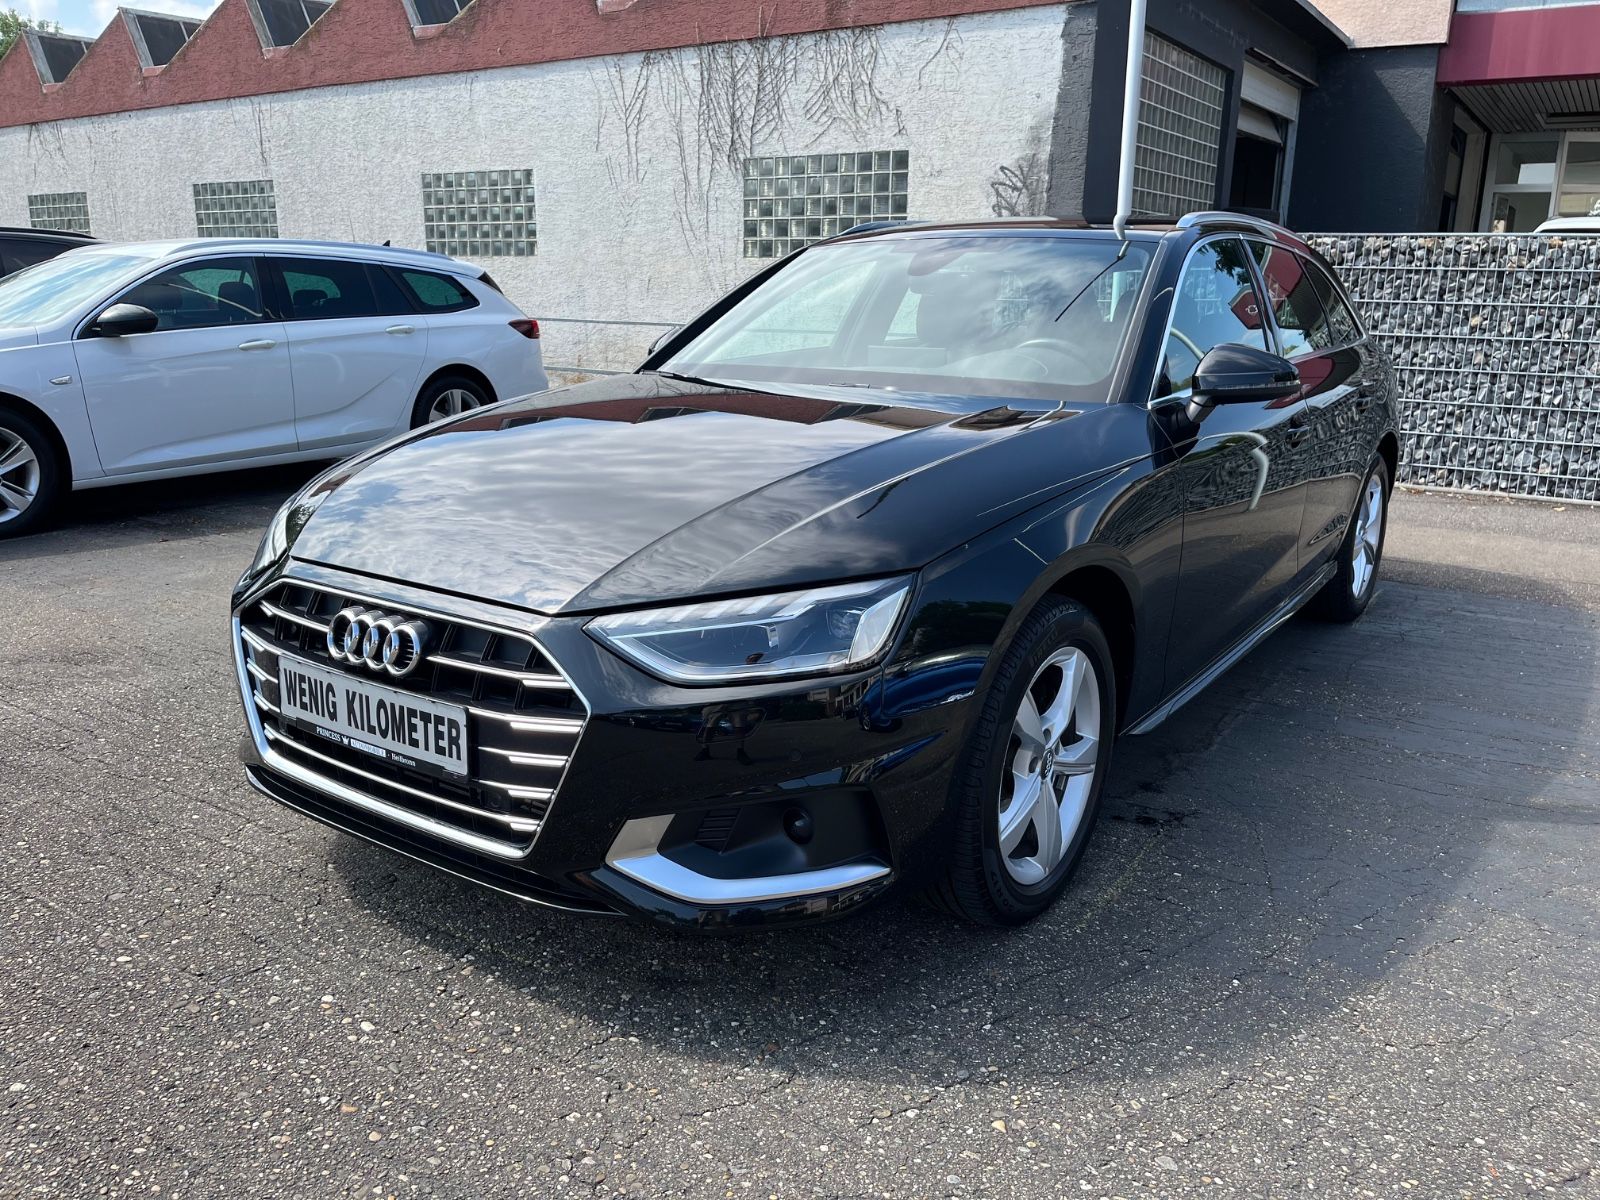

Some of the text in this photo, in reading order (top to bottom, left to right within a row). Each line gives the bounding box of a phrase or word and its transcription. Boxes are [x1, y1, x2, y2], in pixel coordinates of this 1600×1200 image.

[284, 668, 462, 761] WENIG KILOMETER
[316, 726, 341, 742] PRINCESS
